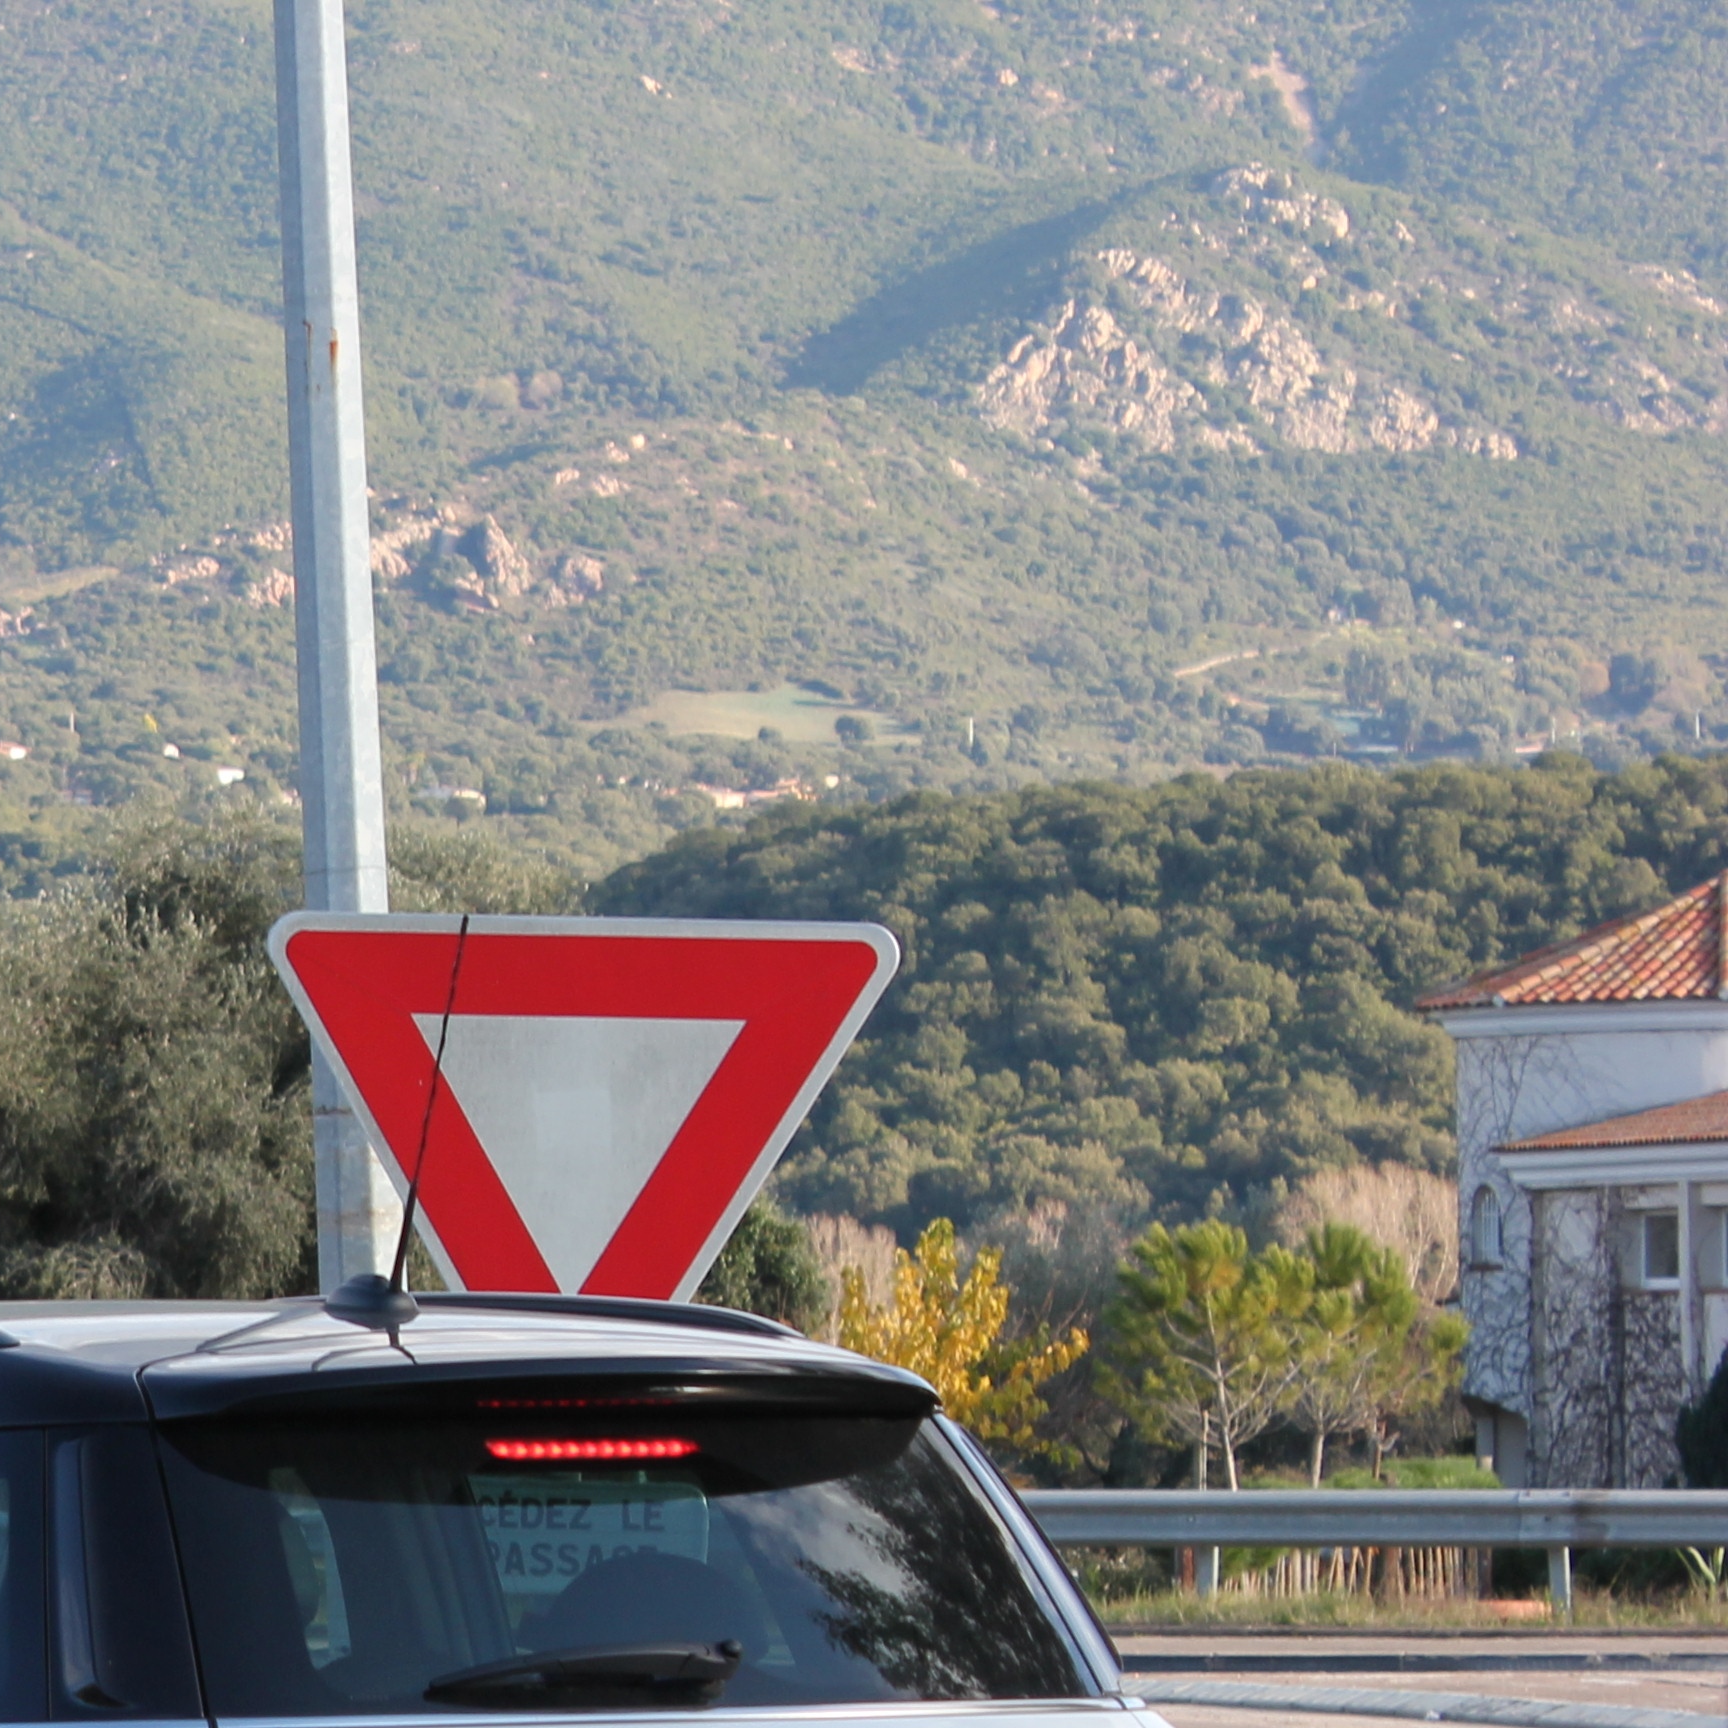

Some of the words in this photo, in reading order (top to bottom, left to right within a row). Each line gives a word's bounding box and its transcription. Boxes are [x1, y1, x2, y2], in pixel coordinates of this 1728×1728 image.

[477, 1490, 592, 1530] CÉDEZ
[621, 1498, 665, 1532] LE
[486, 1539, 659, 1577] ASSA
